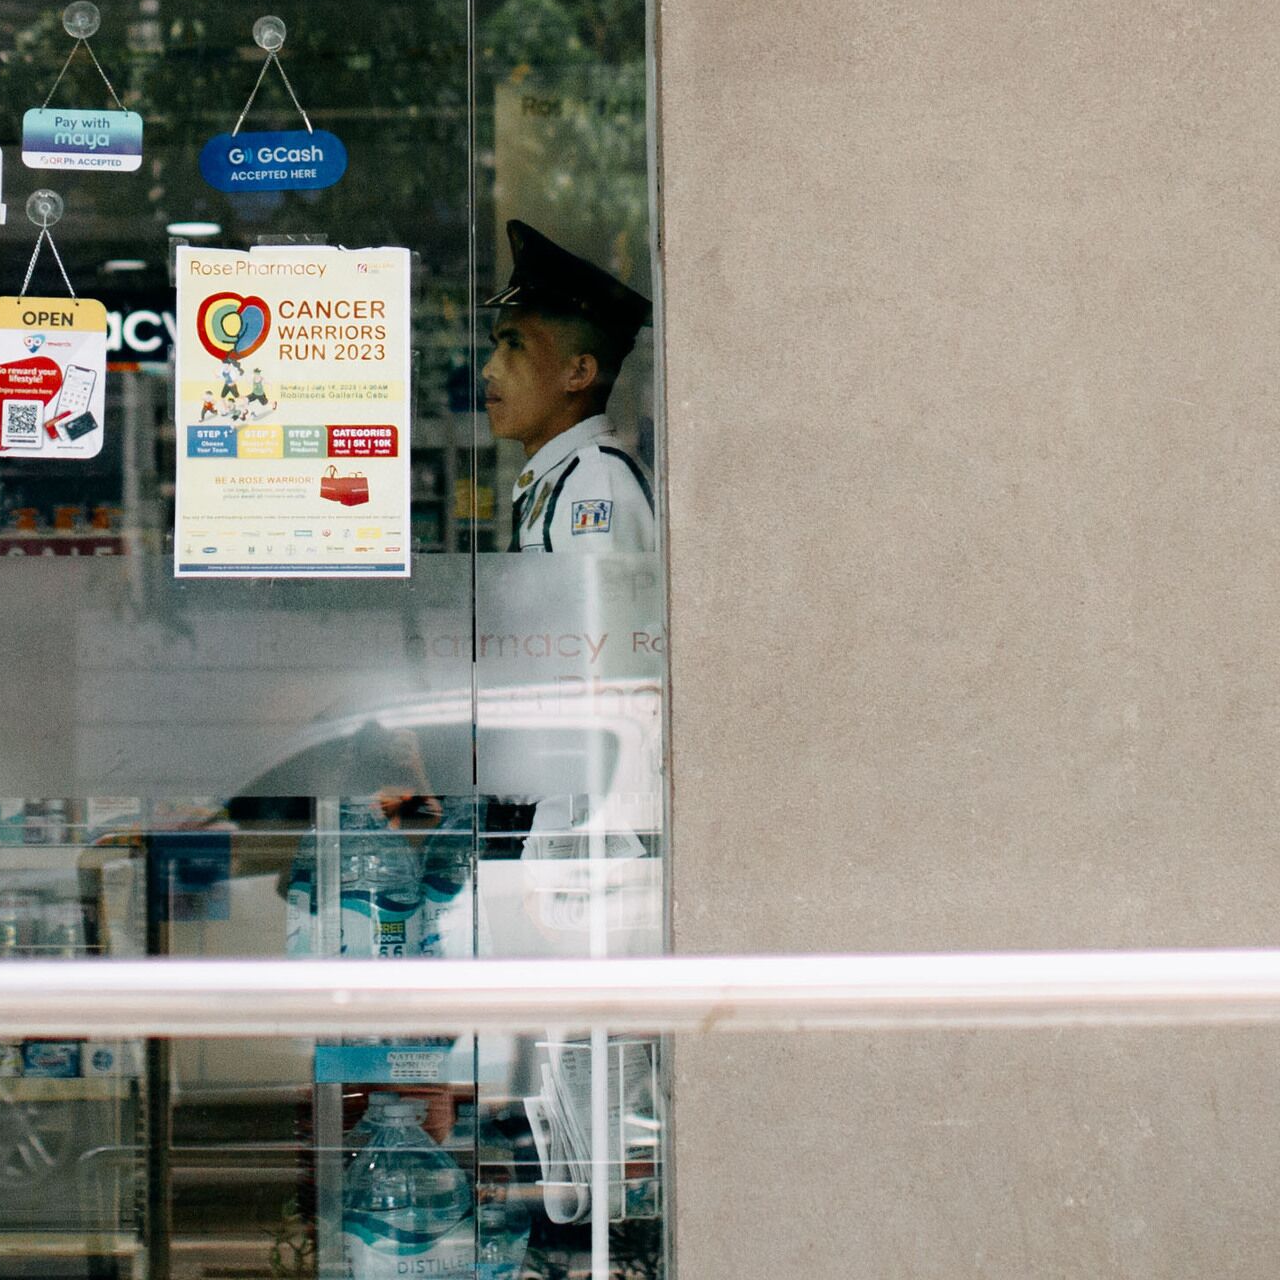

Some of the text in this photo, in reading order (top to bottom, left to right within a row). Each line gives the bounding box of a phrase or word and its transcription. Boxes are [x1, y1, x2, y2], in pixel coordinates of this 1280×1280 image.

[54, 116, 111, 129] Pay with
[54, 132, 111, 150] maya
[257, 145, 324, 164] GCash
[77, 158, 122, 167] ACCEPTED
[230, 168, 318, 181] ACCEPTED HERE
[190, 260, 327, 279] Rose Pharmacy
[278, 299, 386, 320] CANCER
[22, 311, 74, 327] OPEN
[277, 325, 387, 340] WARRIORS
[279, 343, 386, 361] RUN 2023
[7, 367, 38, 376] reward
[196, 429, 222, 438] STEP
[332, 429, 392, 437] CATEGORIES
